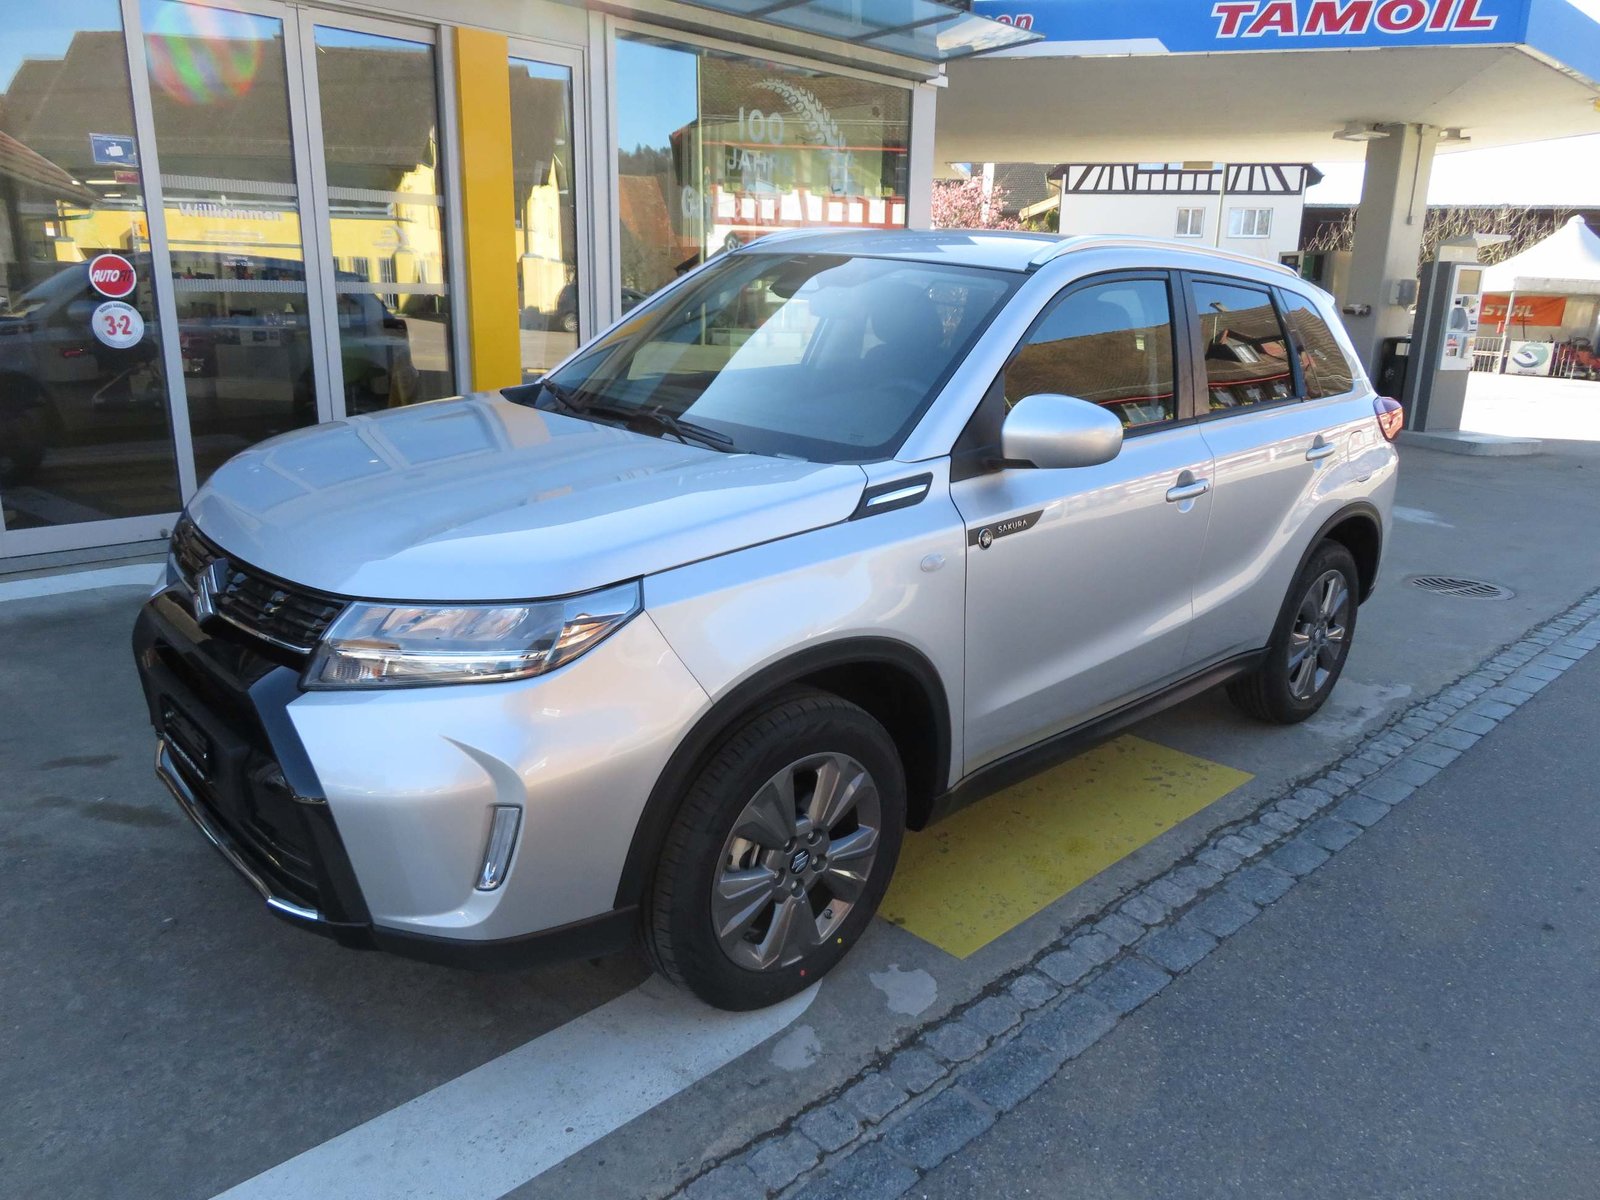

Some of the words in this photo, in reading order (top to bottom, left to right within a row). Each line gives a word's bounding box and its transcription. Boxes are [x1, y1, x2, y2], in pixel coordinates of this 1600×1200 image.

[1211, 0, 1498, 38] TAMOIL
[738, 106, 784, 145] 100
[179, 202, 284, 220] Willkommen
[1481, 304, 1535, 317] STHL
[104, 315, 132, 336] 3+2
[998, 519, 1028, 534] SAKURA
